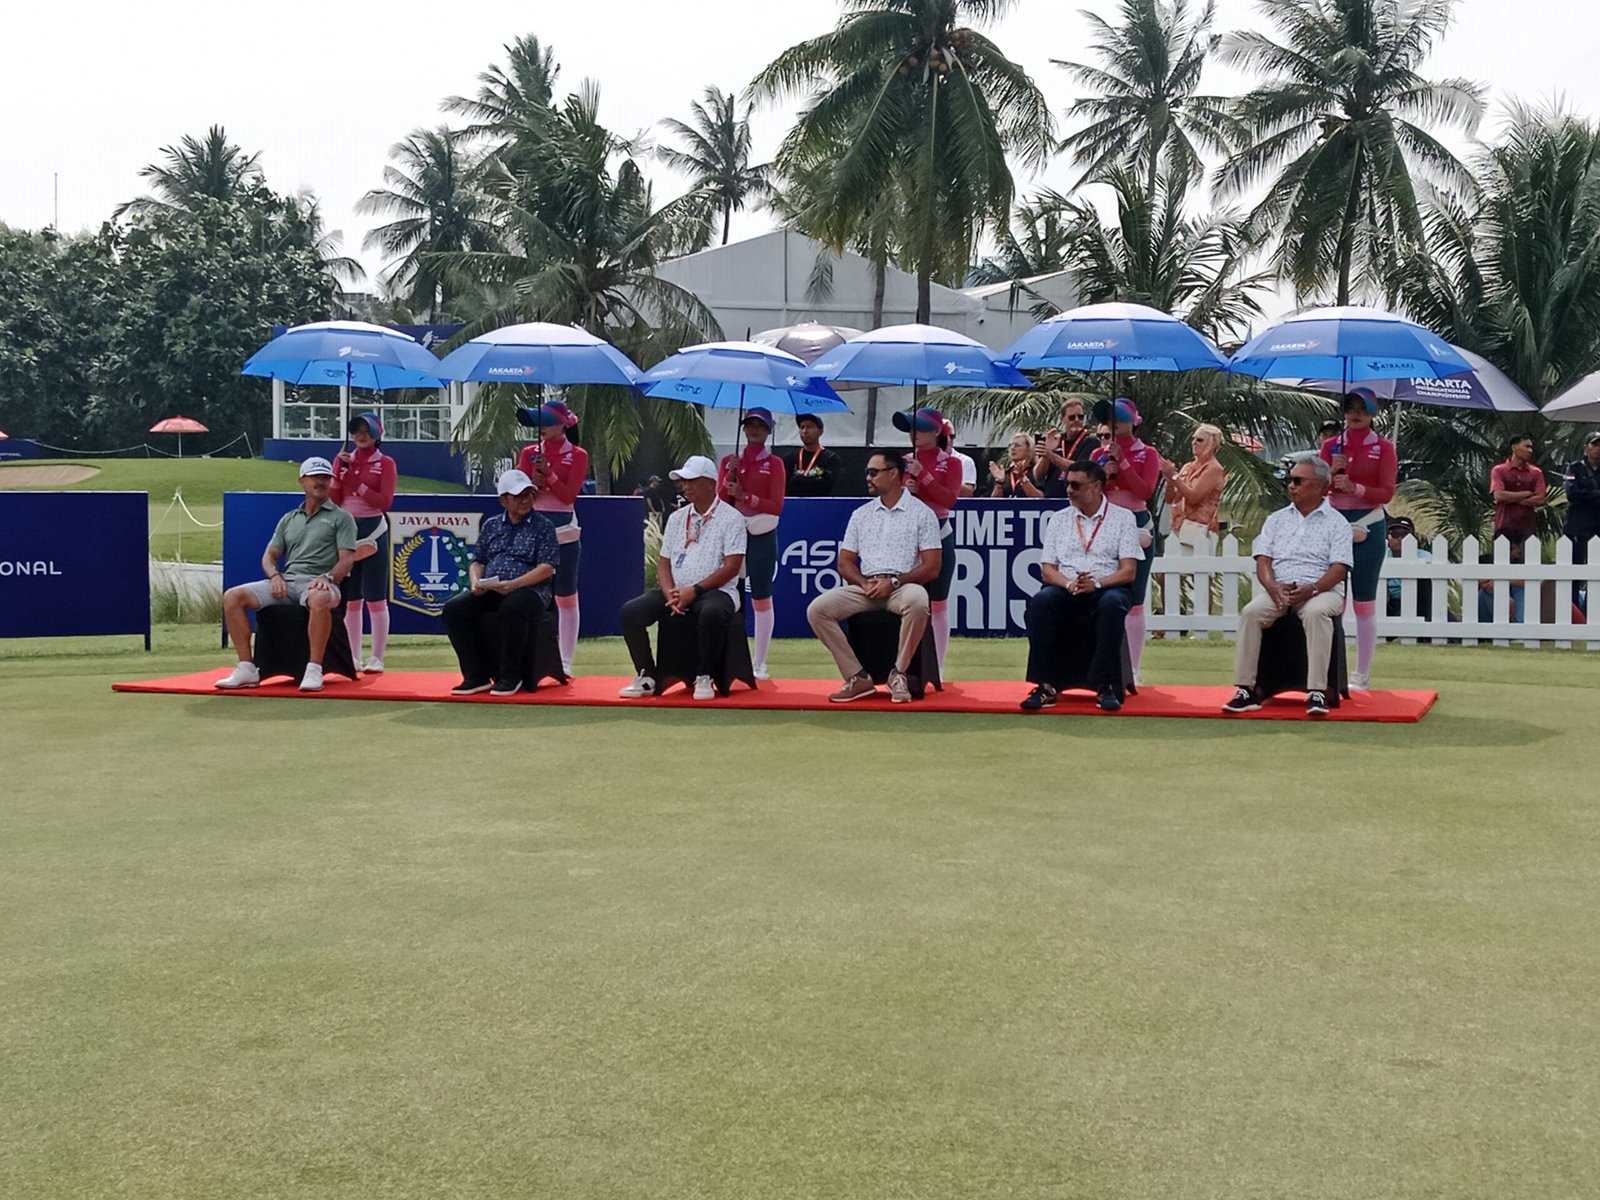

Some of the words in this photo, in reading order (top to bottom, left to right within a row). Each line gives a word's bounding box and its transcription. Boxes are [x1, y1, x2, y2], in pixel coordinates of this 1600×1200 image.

[1067, 341, 1104, 349] JAKARTA
[1410, 377, 1472, 389] JAKARTA
[399, 516, 431, 526] JAYA
[437, 516, 470, 526] RAYA
[781, 540, 843, 567] AS
[791, 568, 848, 595] TO
